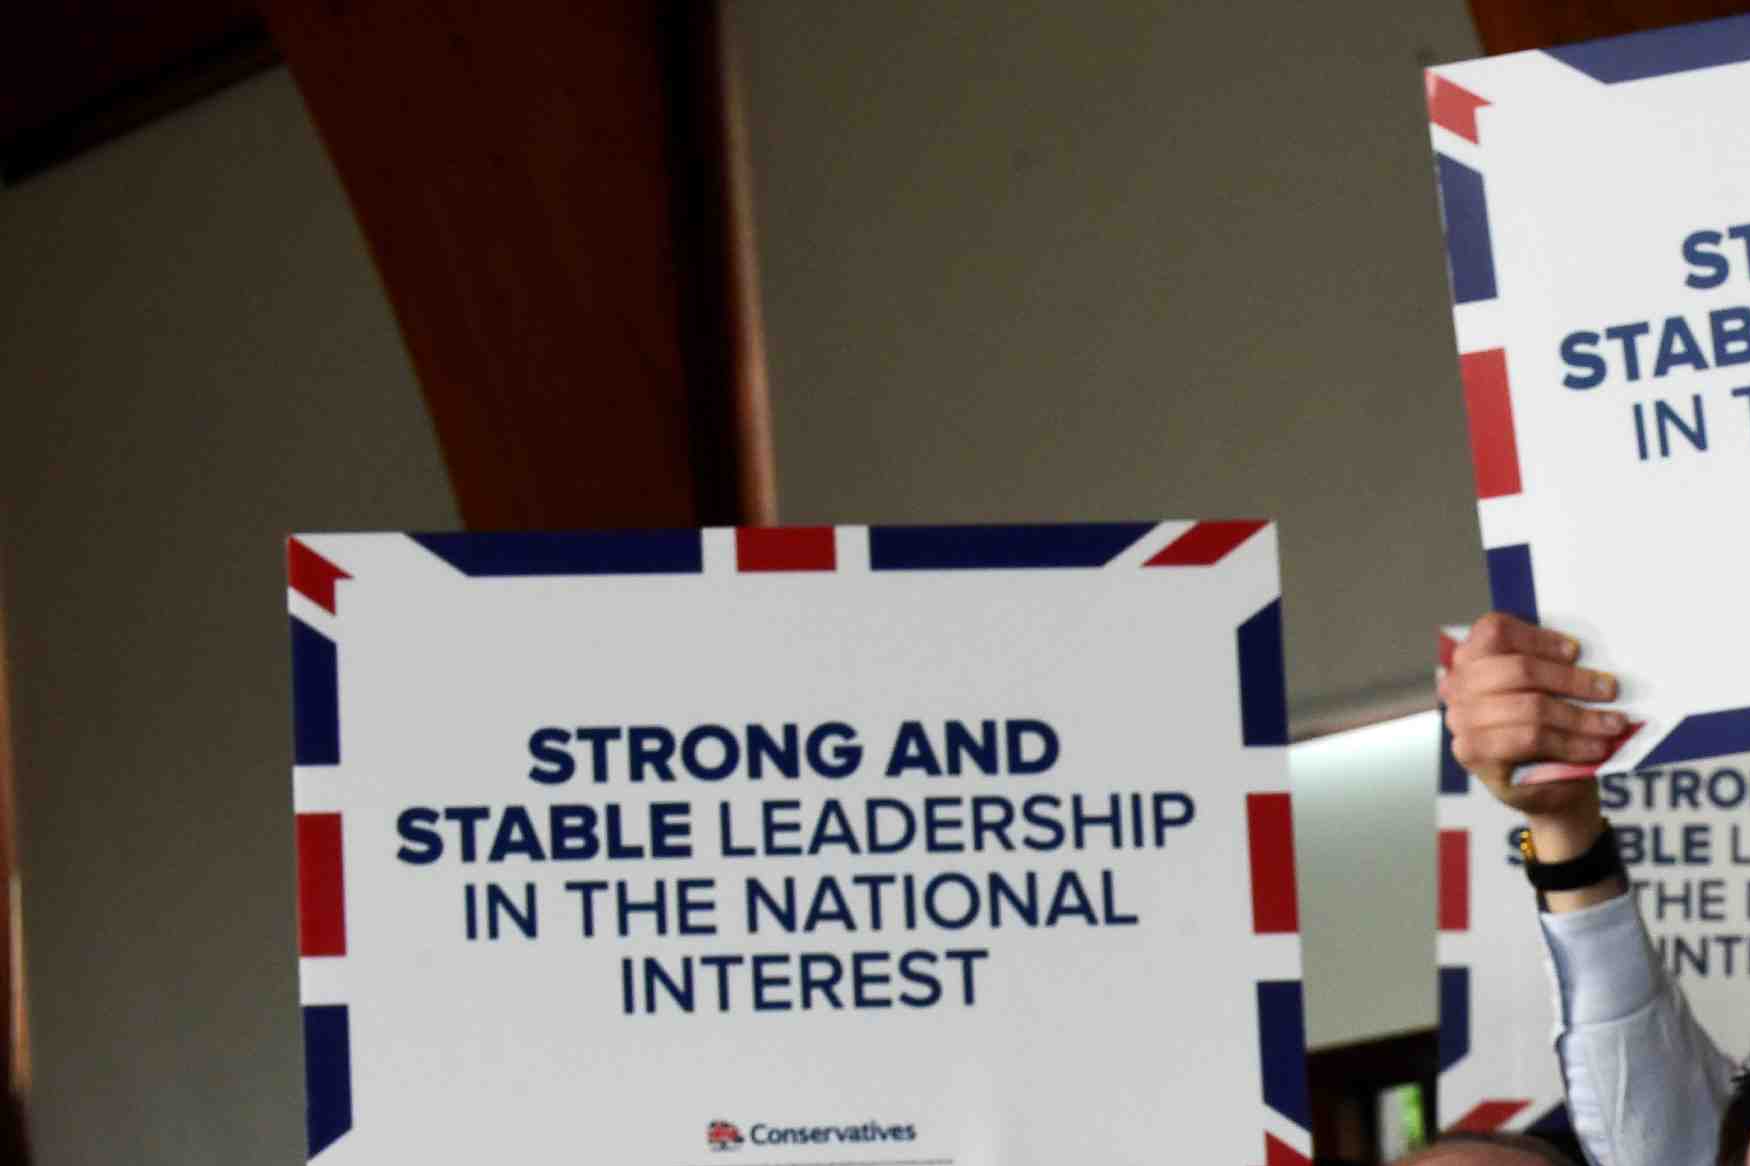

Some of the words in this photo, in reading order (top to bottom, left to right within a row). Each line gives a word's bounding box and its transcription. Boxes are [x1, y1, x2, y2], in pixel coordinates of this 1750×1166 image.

[1633, 394, 1708, 460] IN
[528, 721, 864, 786] STRONG
[884, 718, 1060, 778] AND
[396, 801, 693, 866] STABLE
[719, 791, 1196, 858] LEADERSHIP
[464, 882, 538, 940] IN
[564, 878, 717, 938] THE
[745, 869, 1139, 934] NATIONAL
[622, 948, 989, 1015] INTEREST
[750, 1120, 917, 1146] Conservatives
